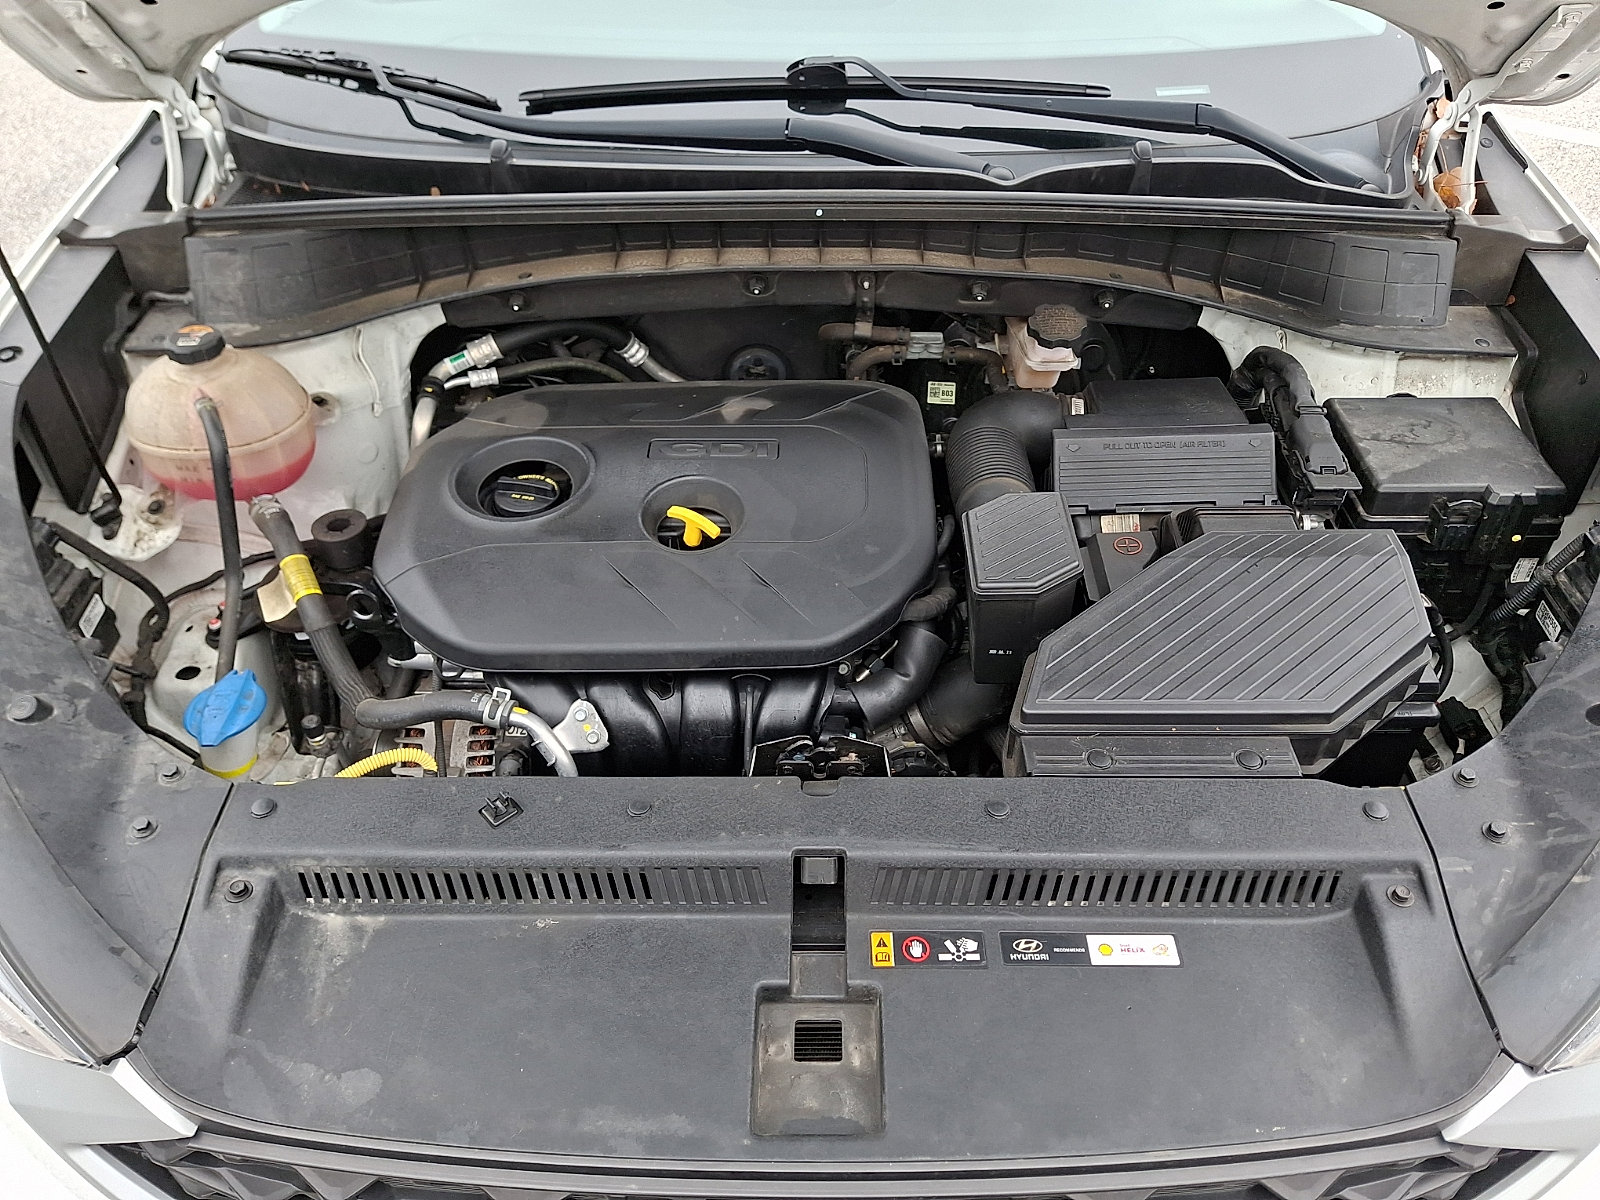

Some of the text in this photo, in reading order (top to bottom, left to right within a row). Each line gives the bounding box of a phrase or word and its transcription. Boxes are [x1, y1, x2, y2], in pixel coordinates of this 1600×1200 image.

[659, 442, 769, 458] GDI
[1124, 442, 1140, 450] OUT
[1154, 441, 1177, 449] OPEN
[1010, 953, 1050, 961] HYUNDAI
